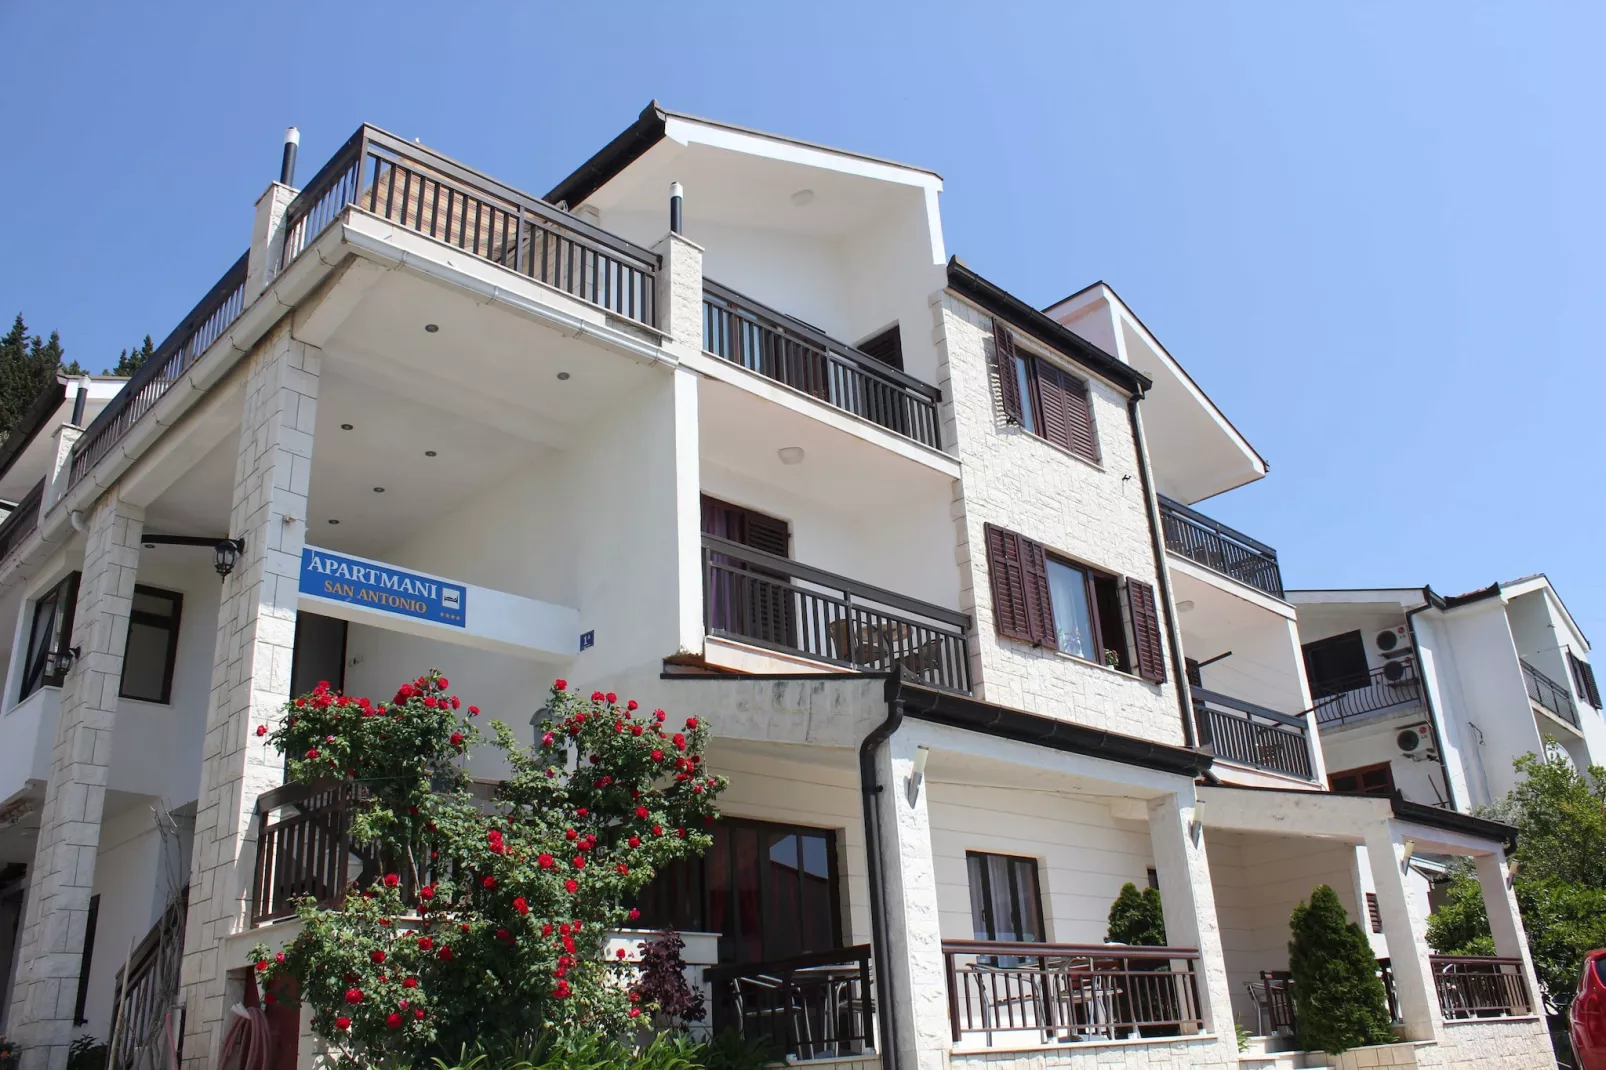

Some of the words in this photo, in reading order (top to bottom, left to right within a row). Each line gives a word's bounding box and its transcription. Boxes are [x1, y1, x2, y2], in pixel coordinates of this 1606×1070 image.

[307, 555, 438, 600] APARTMANI
[324, 579, 354, 598] SAN
[357, 588, 427, 614] ANTONIO
